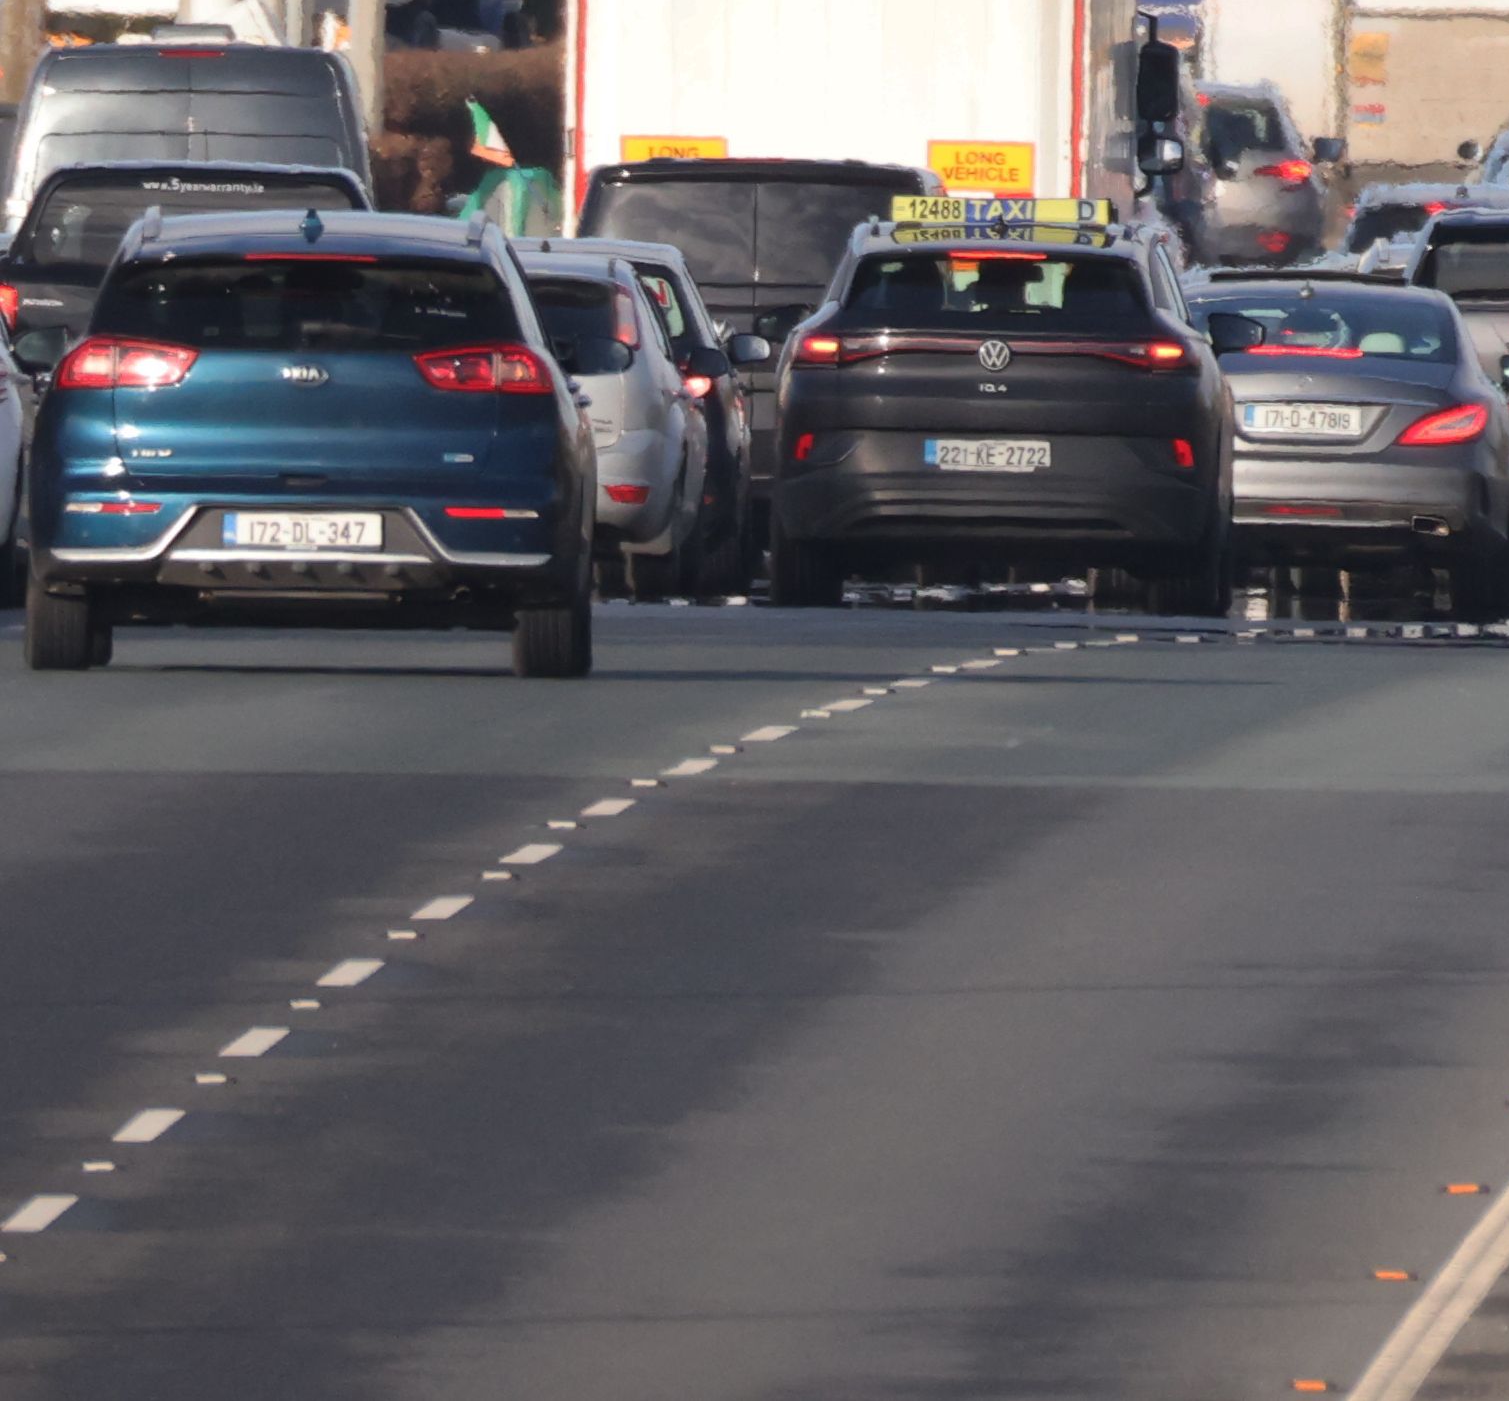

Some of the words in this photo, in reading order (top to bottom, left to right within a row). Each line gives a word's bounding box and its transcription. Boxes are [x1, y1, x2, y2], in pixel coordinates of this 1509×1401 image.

[955, 150, 1007, 166] LONG
[942, 166, 1020, 183] VEHICLE
[908, 199, 962, 220] 12488
[968, 199, 1034, 221] TAXI
[1077, 200, 1096, 221] D
[1265, 410, 1351, 429] 171-D-47819
[940, 445, 1048, 467] 221-KE-2722
[249, 520, 366, 546] 172-DL-347
